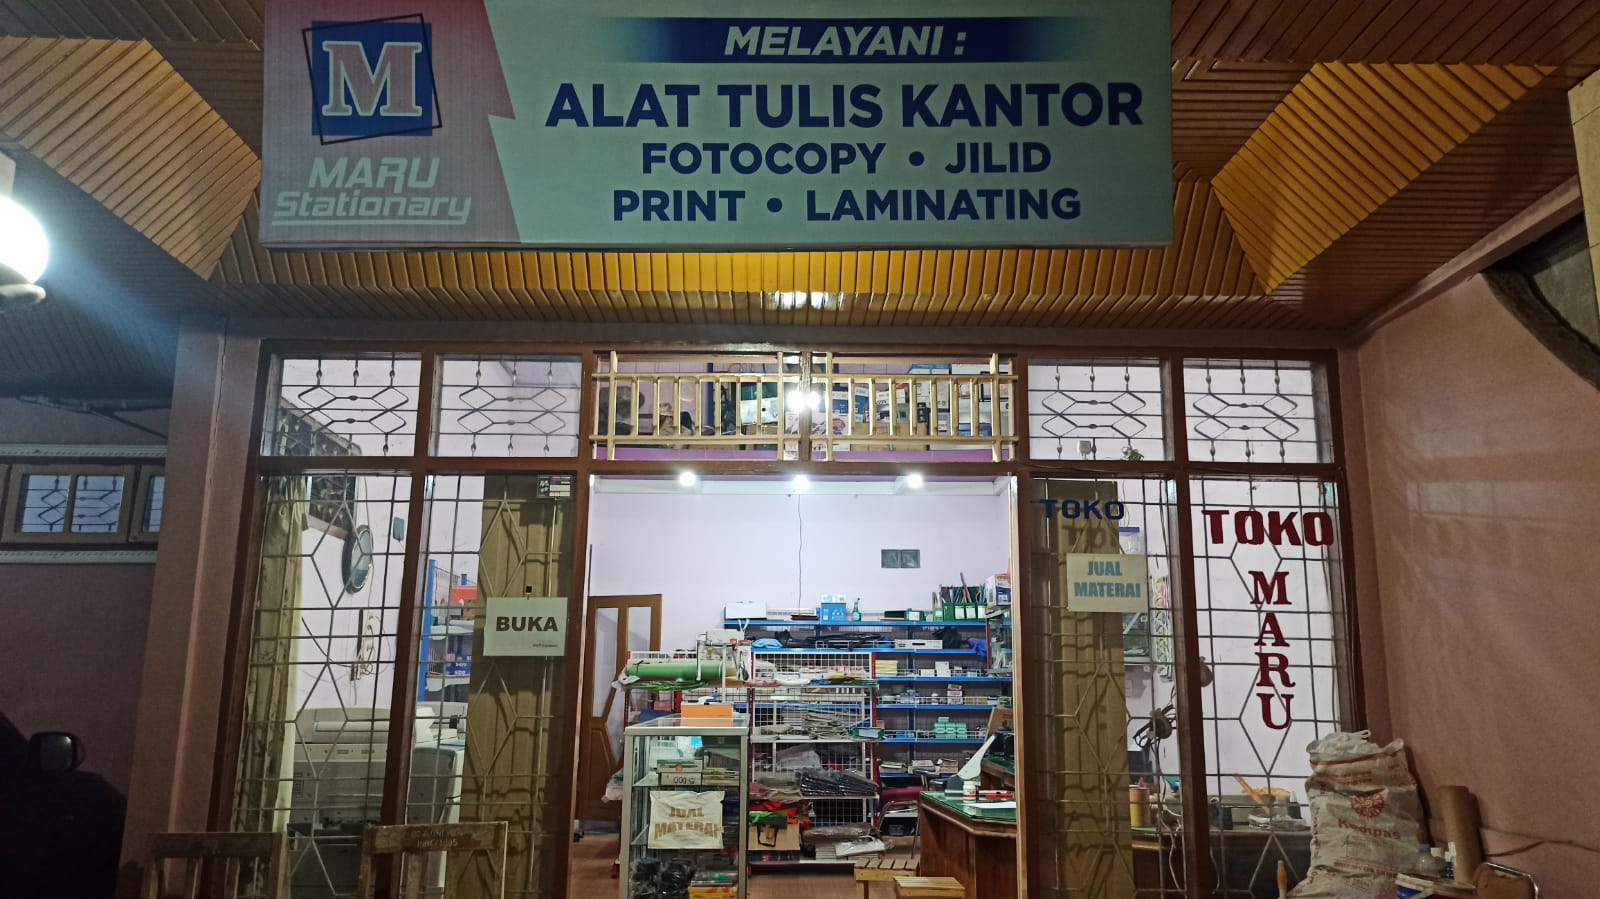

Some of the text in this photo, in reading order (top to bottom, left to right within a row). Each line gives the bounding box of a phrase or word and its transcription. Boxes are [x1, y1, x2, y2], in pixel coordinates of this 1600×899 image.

[724, 26, 944, 56] MELAYANI
[322, 41, 422, 117] M
[545, 82, 1144, 128] ALAT TULIS KANTOR
[308, 157, 440, 193] MARU
[642, 141, 1051, 175] FOTOCOPY JILID
[272, 189, 472, 225] Stationary
[613, 188, 1081, 222] PRINT LAMINATING
[1039, 499, 1125, 520] TOKO
[1201, 509, 1334, 546] TOKO
[1088, 561, 1123, 576] JUAL
[1074, 582, 1140, 598] MATERAI
[495, 616, 558, 632] BUKA
[1248, 570, 1296, 730] MARU
[668, 806, 704, 818] JUAL
